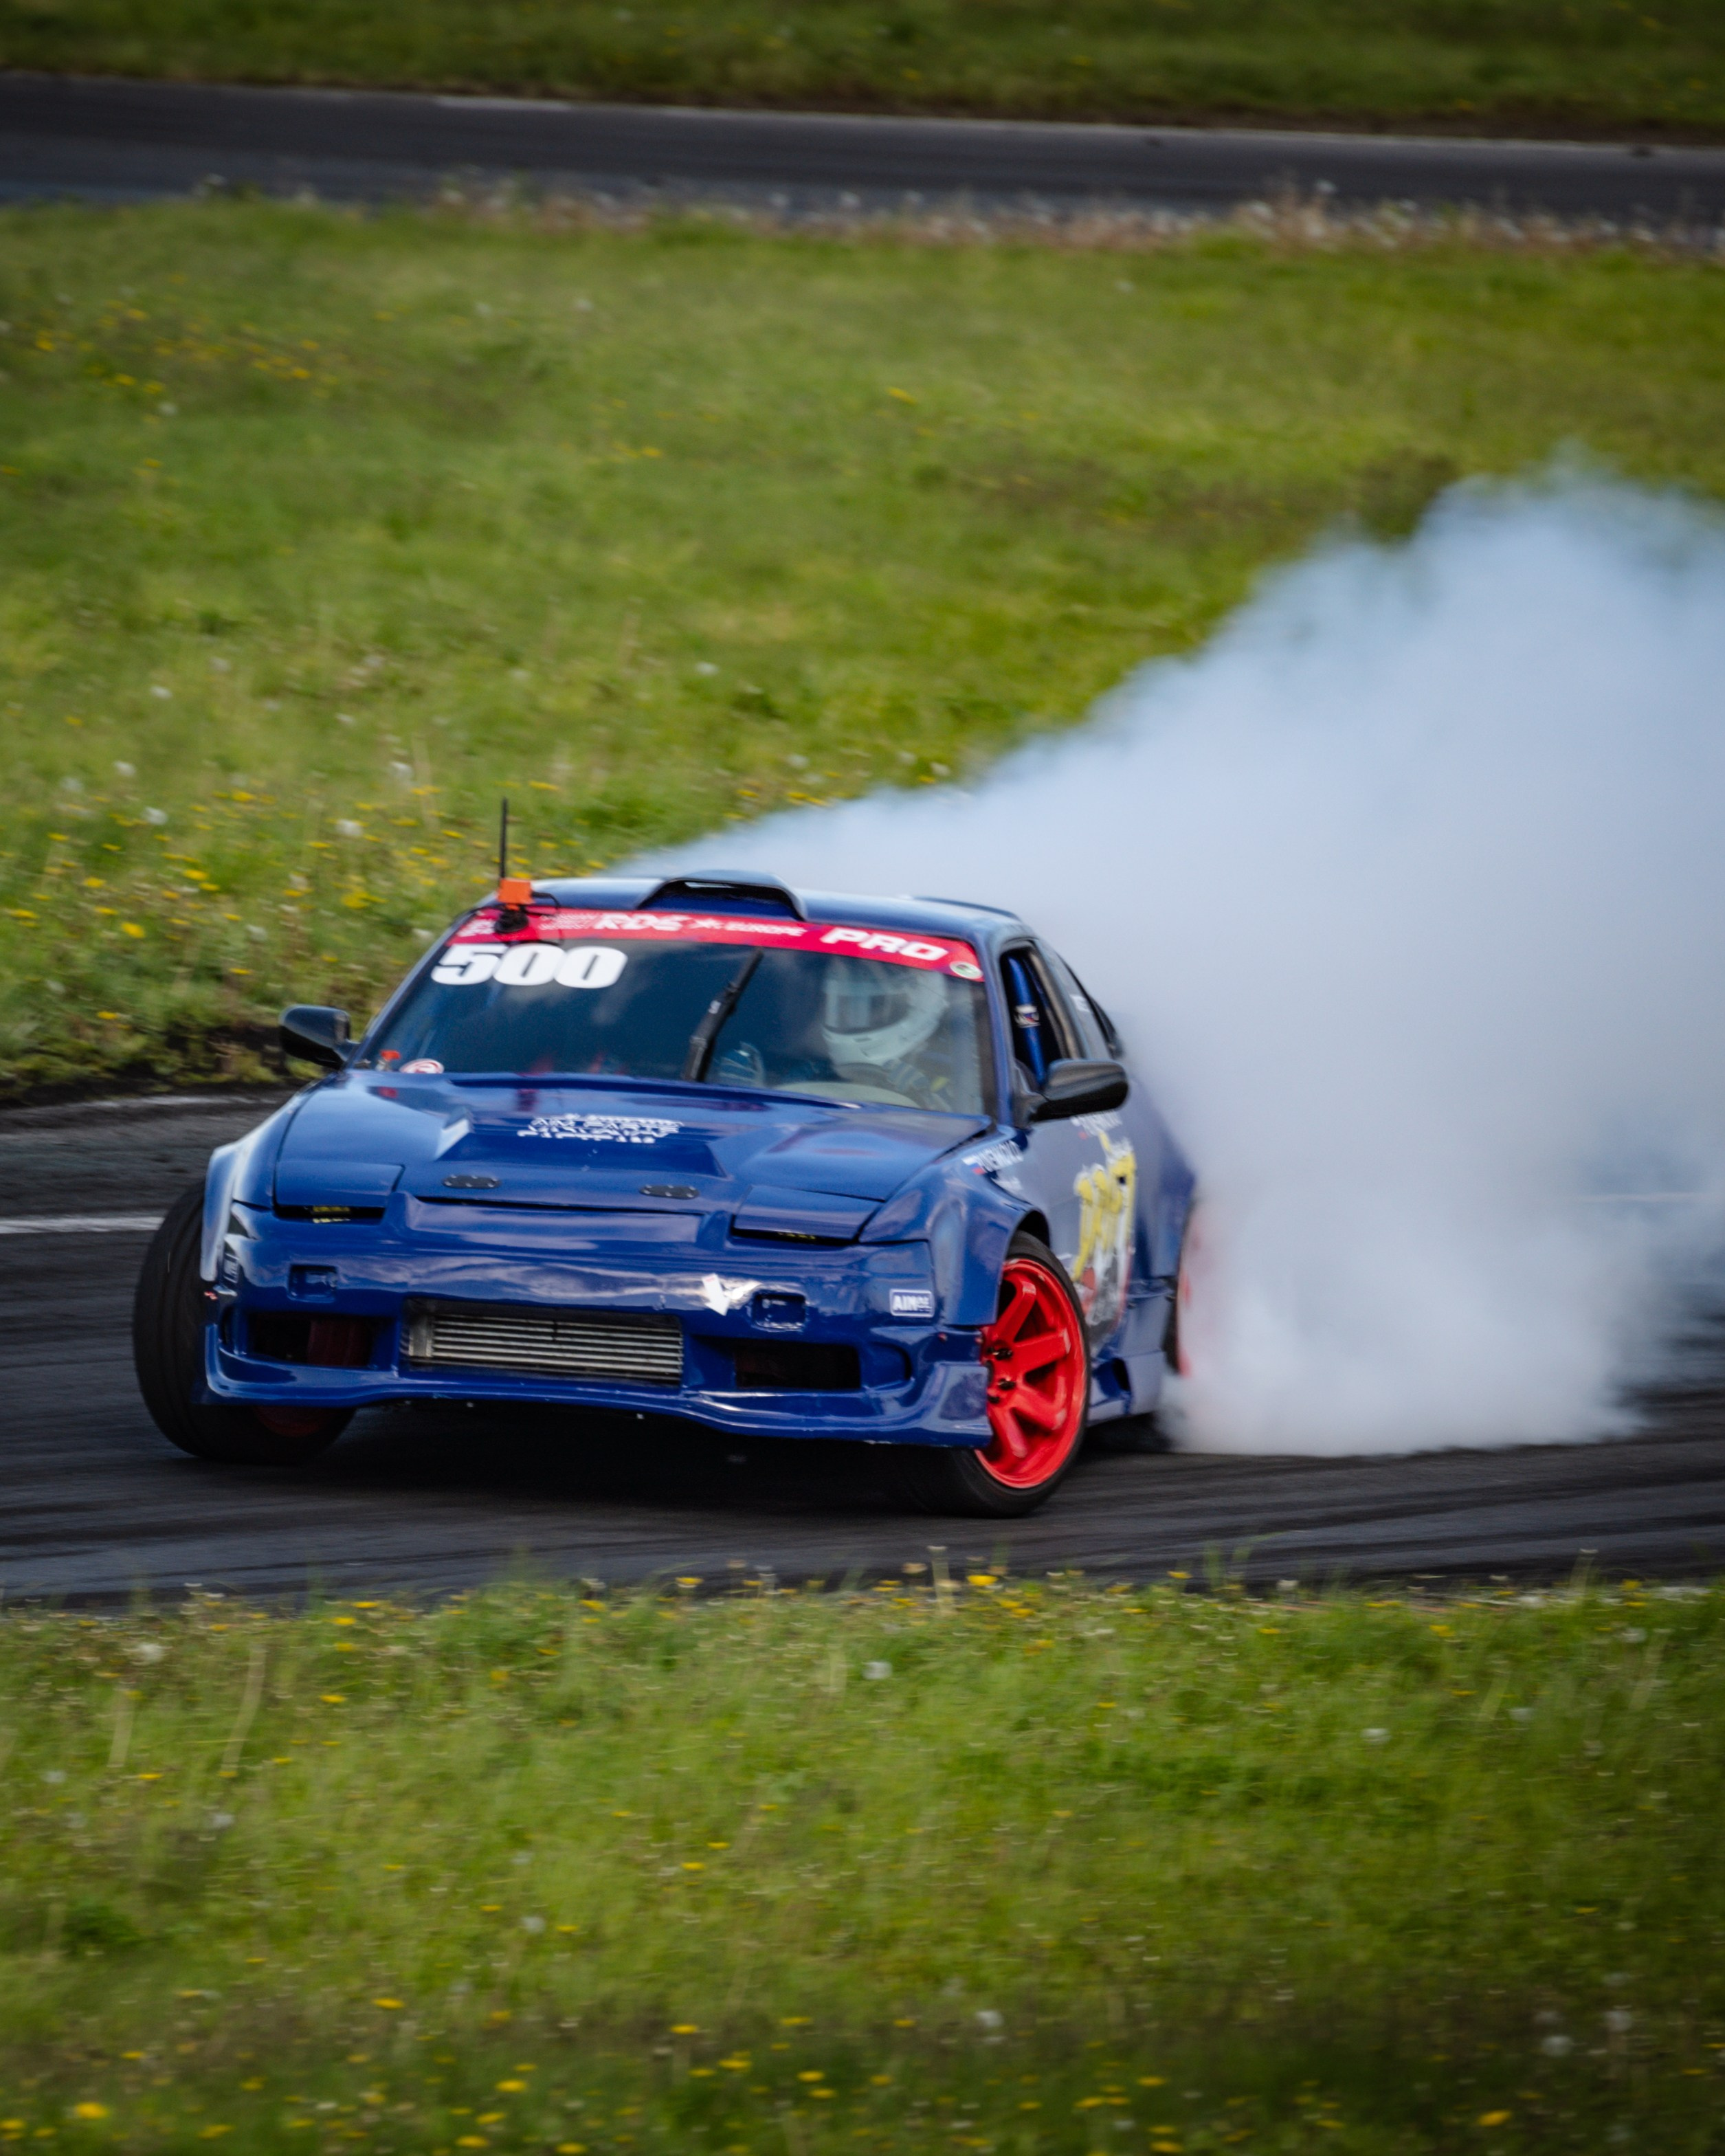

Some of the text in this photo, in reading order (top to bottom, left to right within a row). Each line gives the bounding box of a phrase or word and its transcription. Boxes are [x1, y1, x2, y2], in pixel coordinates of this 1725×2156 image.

[590, 913, 691, 931] RDS
[724, 921, 808, 936] EUROPE
[819, 927, 948, 961] PRO
[431, 943, 628, 988] 500
